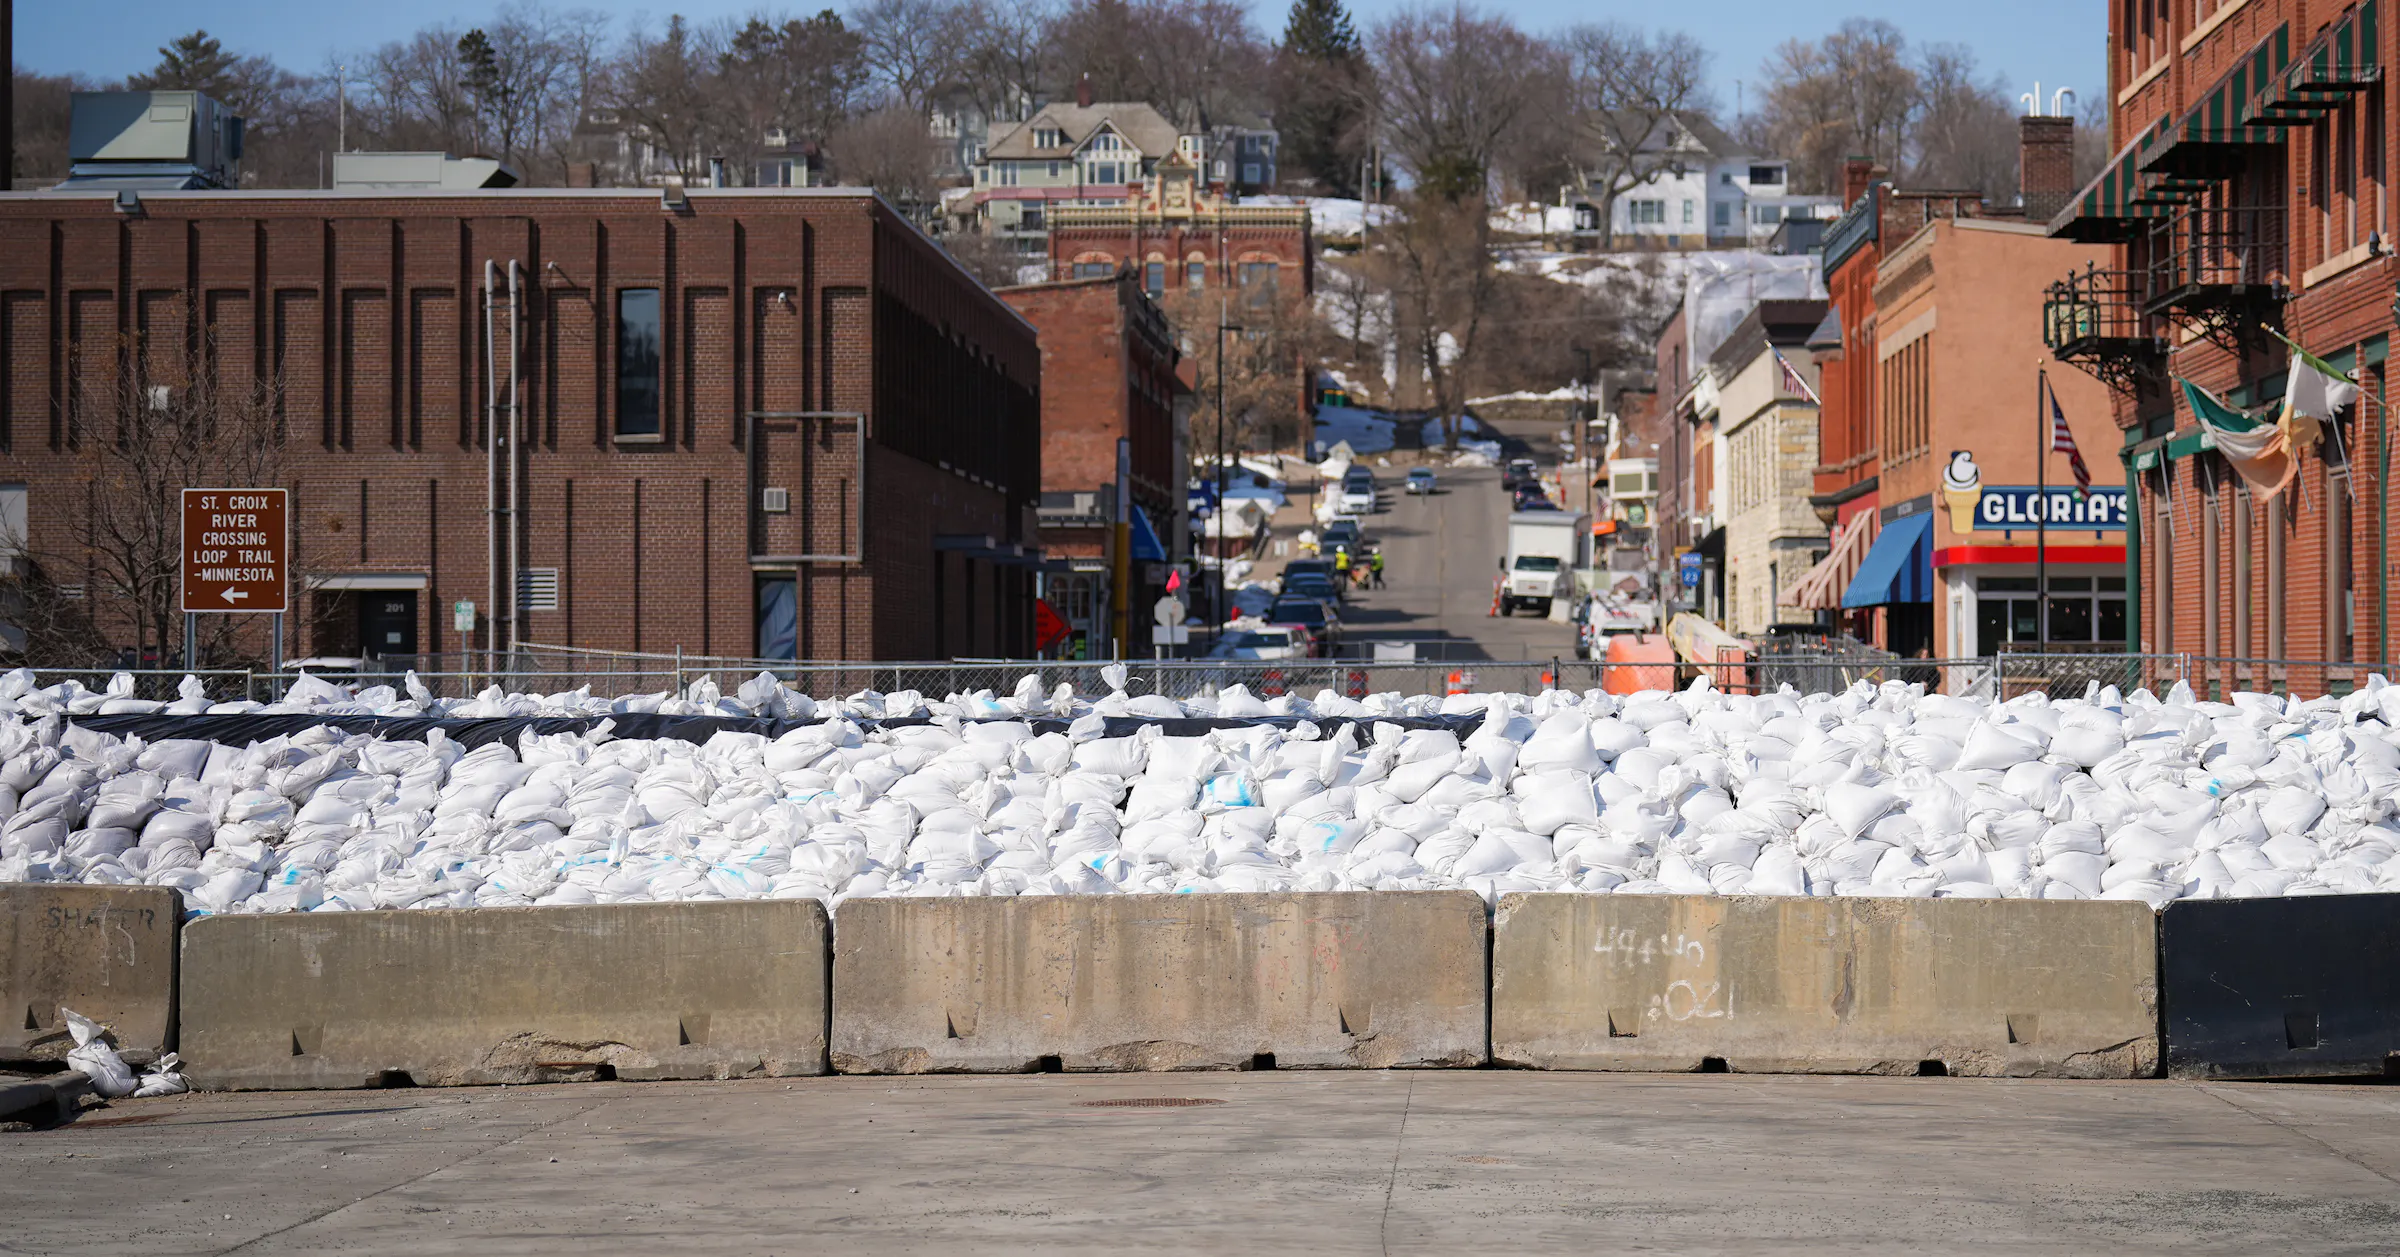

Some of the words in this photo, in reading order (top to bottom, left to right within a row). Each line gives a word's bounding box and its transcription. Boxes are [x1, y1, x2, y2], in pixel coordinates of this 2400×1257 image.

[201, 496, 220, 510] ST.
[229, 496, 268, 510] CROIX
[211, 513, 257, 528] RIVER
[202, 531, 267, 546] CROSSING
[193, 549, 228, 564] LOOP
[237, 549, 276, 564] TRAIL
[193, 567, 275, 582] -MINNESOTA
[385, 602, 405, 613] 201
